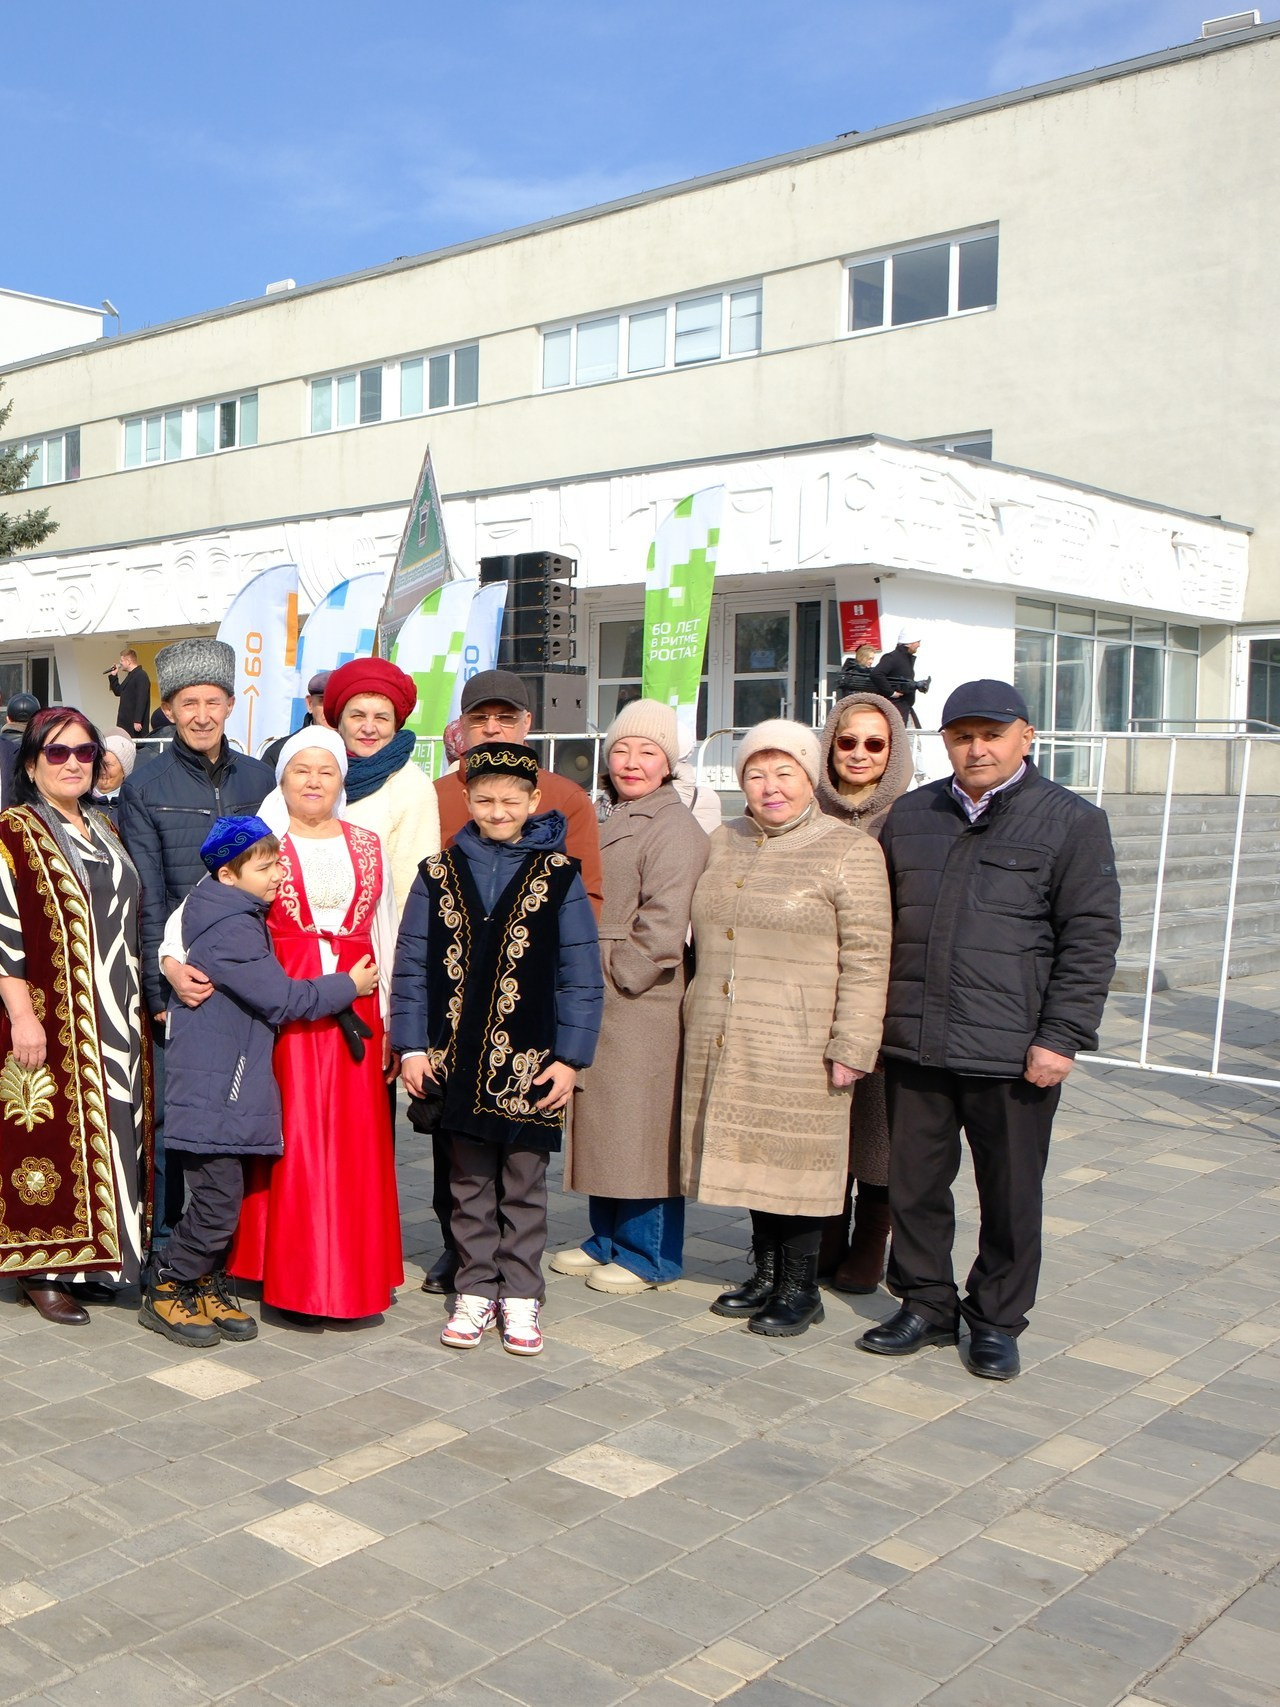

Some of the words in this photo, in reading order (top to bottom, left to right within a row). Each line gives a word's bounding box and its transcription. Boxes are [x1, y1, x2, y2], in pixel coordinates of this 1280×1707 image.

[652, 623, 671, 635] 60
[675, 619, 701, 633] ЛЕТ
[651, 638, 658, 647] В
[661, 633, 698, 646] РИТМЕ
[244, 631, 263, 677] 60
[650, 646, 697, 661] РОСТА!
